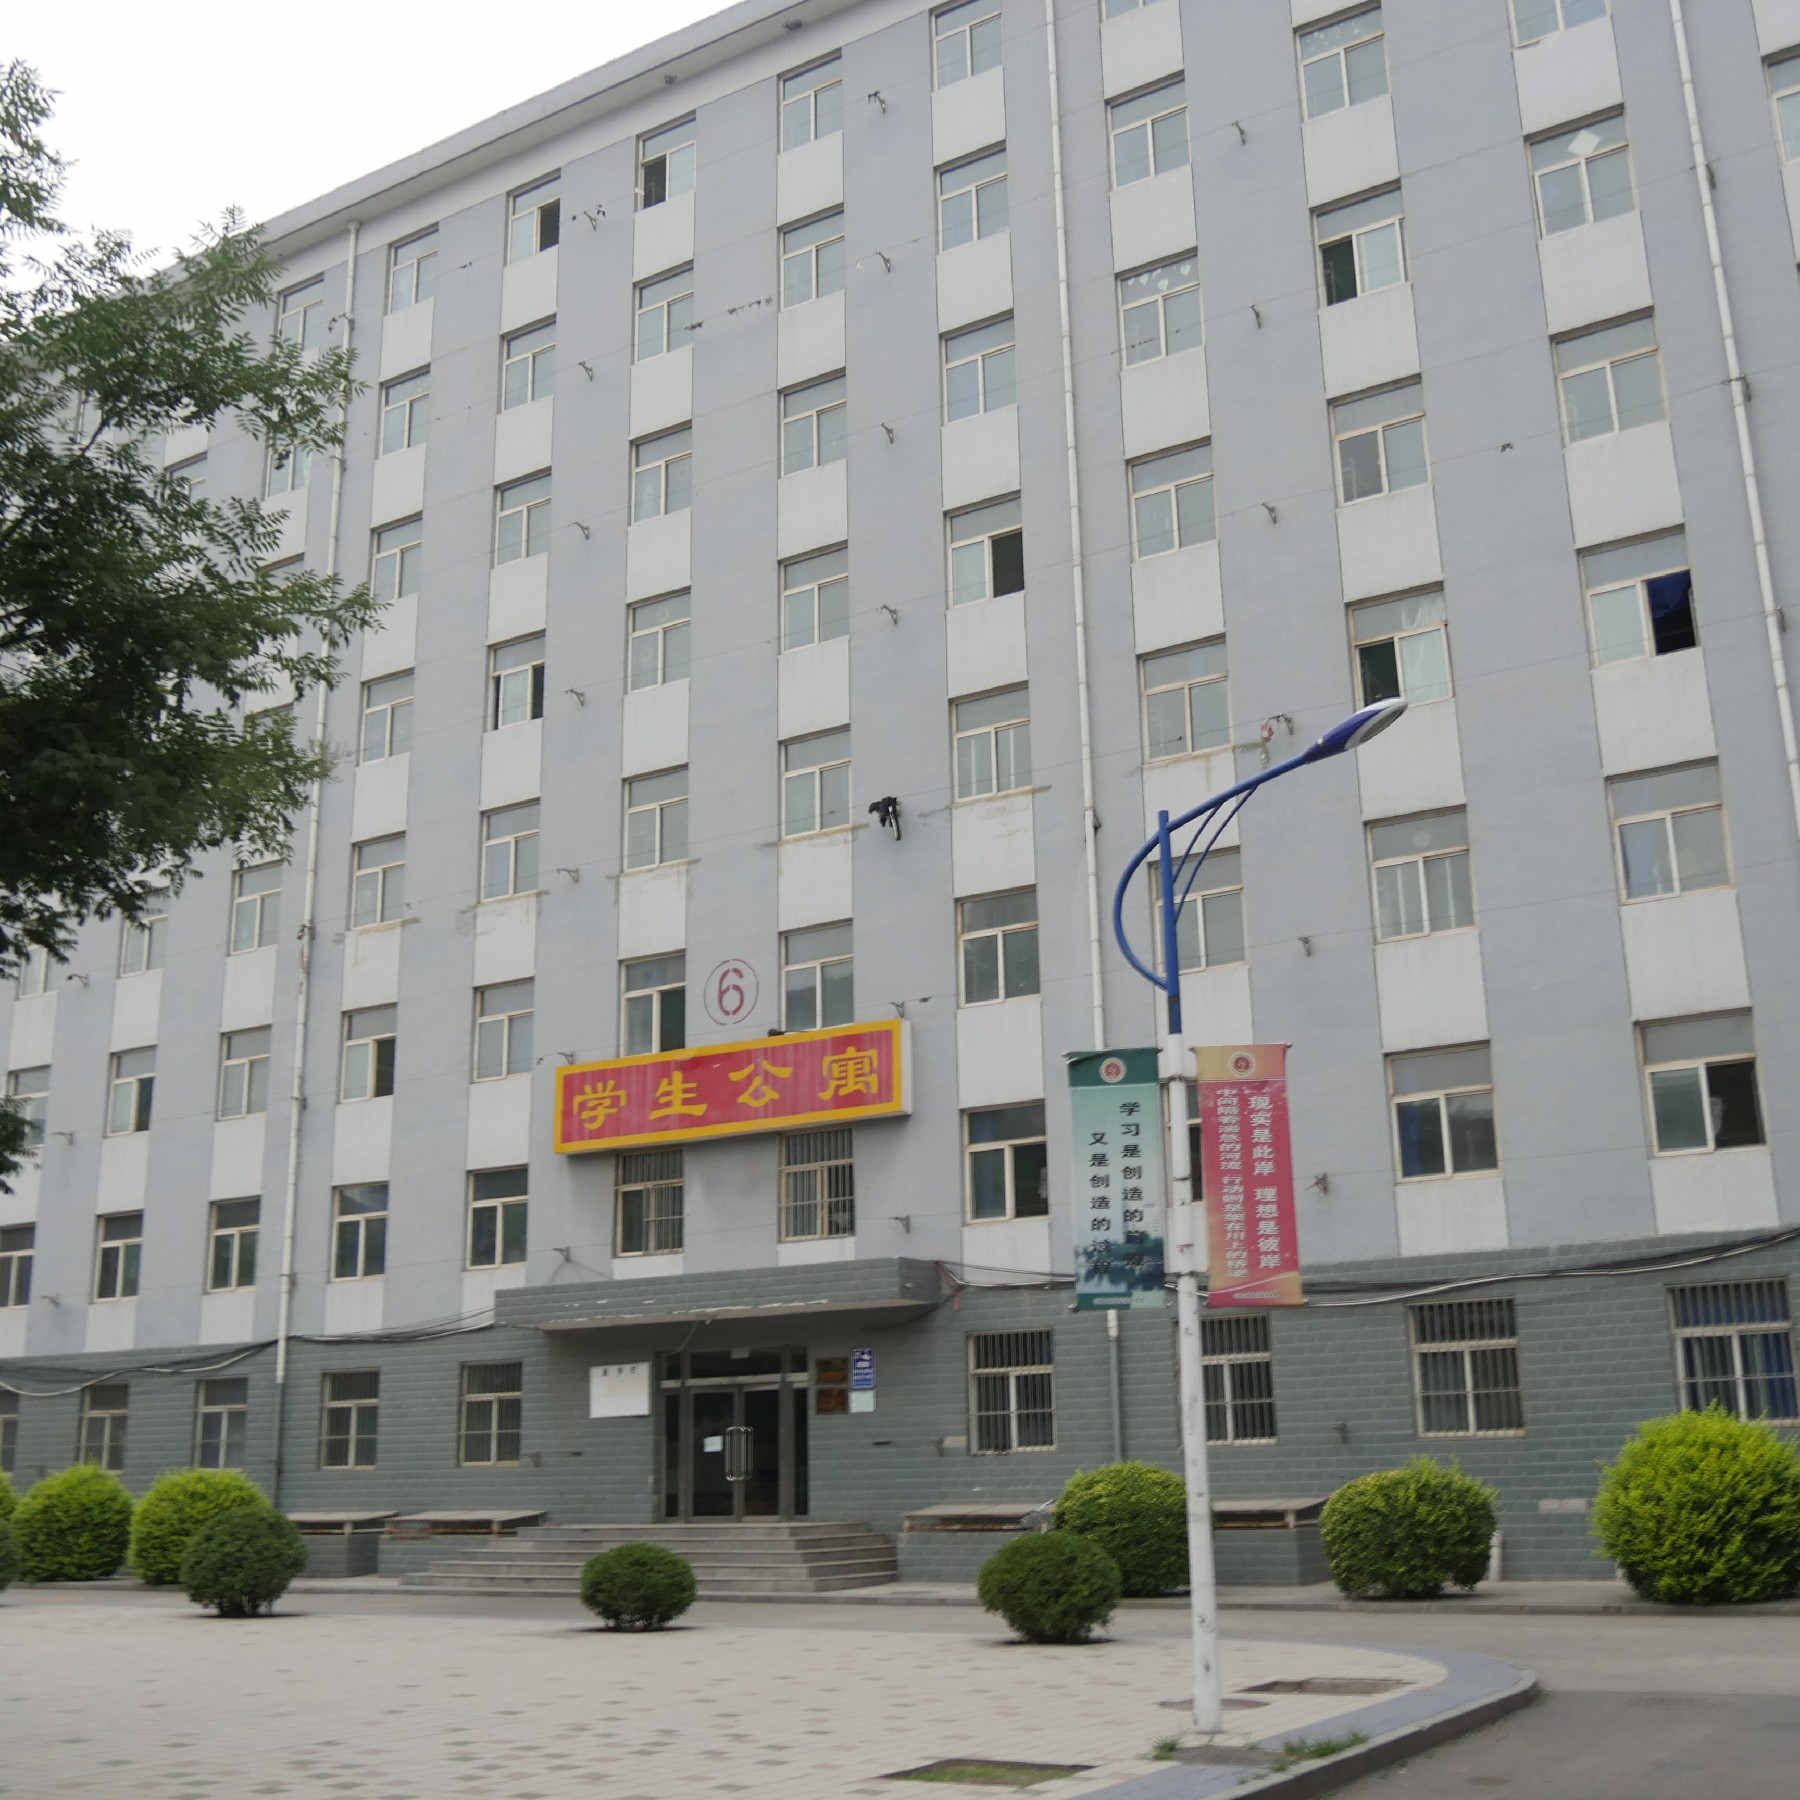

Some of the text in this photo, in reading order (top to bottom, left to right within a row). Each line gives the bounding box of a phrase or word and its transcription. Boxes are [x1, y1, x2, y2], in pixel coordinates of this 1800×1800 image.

[718, 967, 744, 1017] 6
[573, 1047, 878, 1130] 学生公寓
[1248, 1095, 1276, 1176] 现实是此岸
[1254, 1188, 1281, 1269] 理想是彼岸
